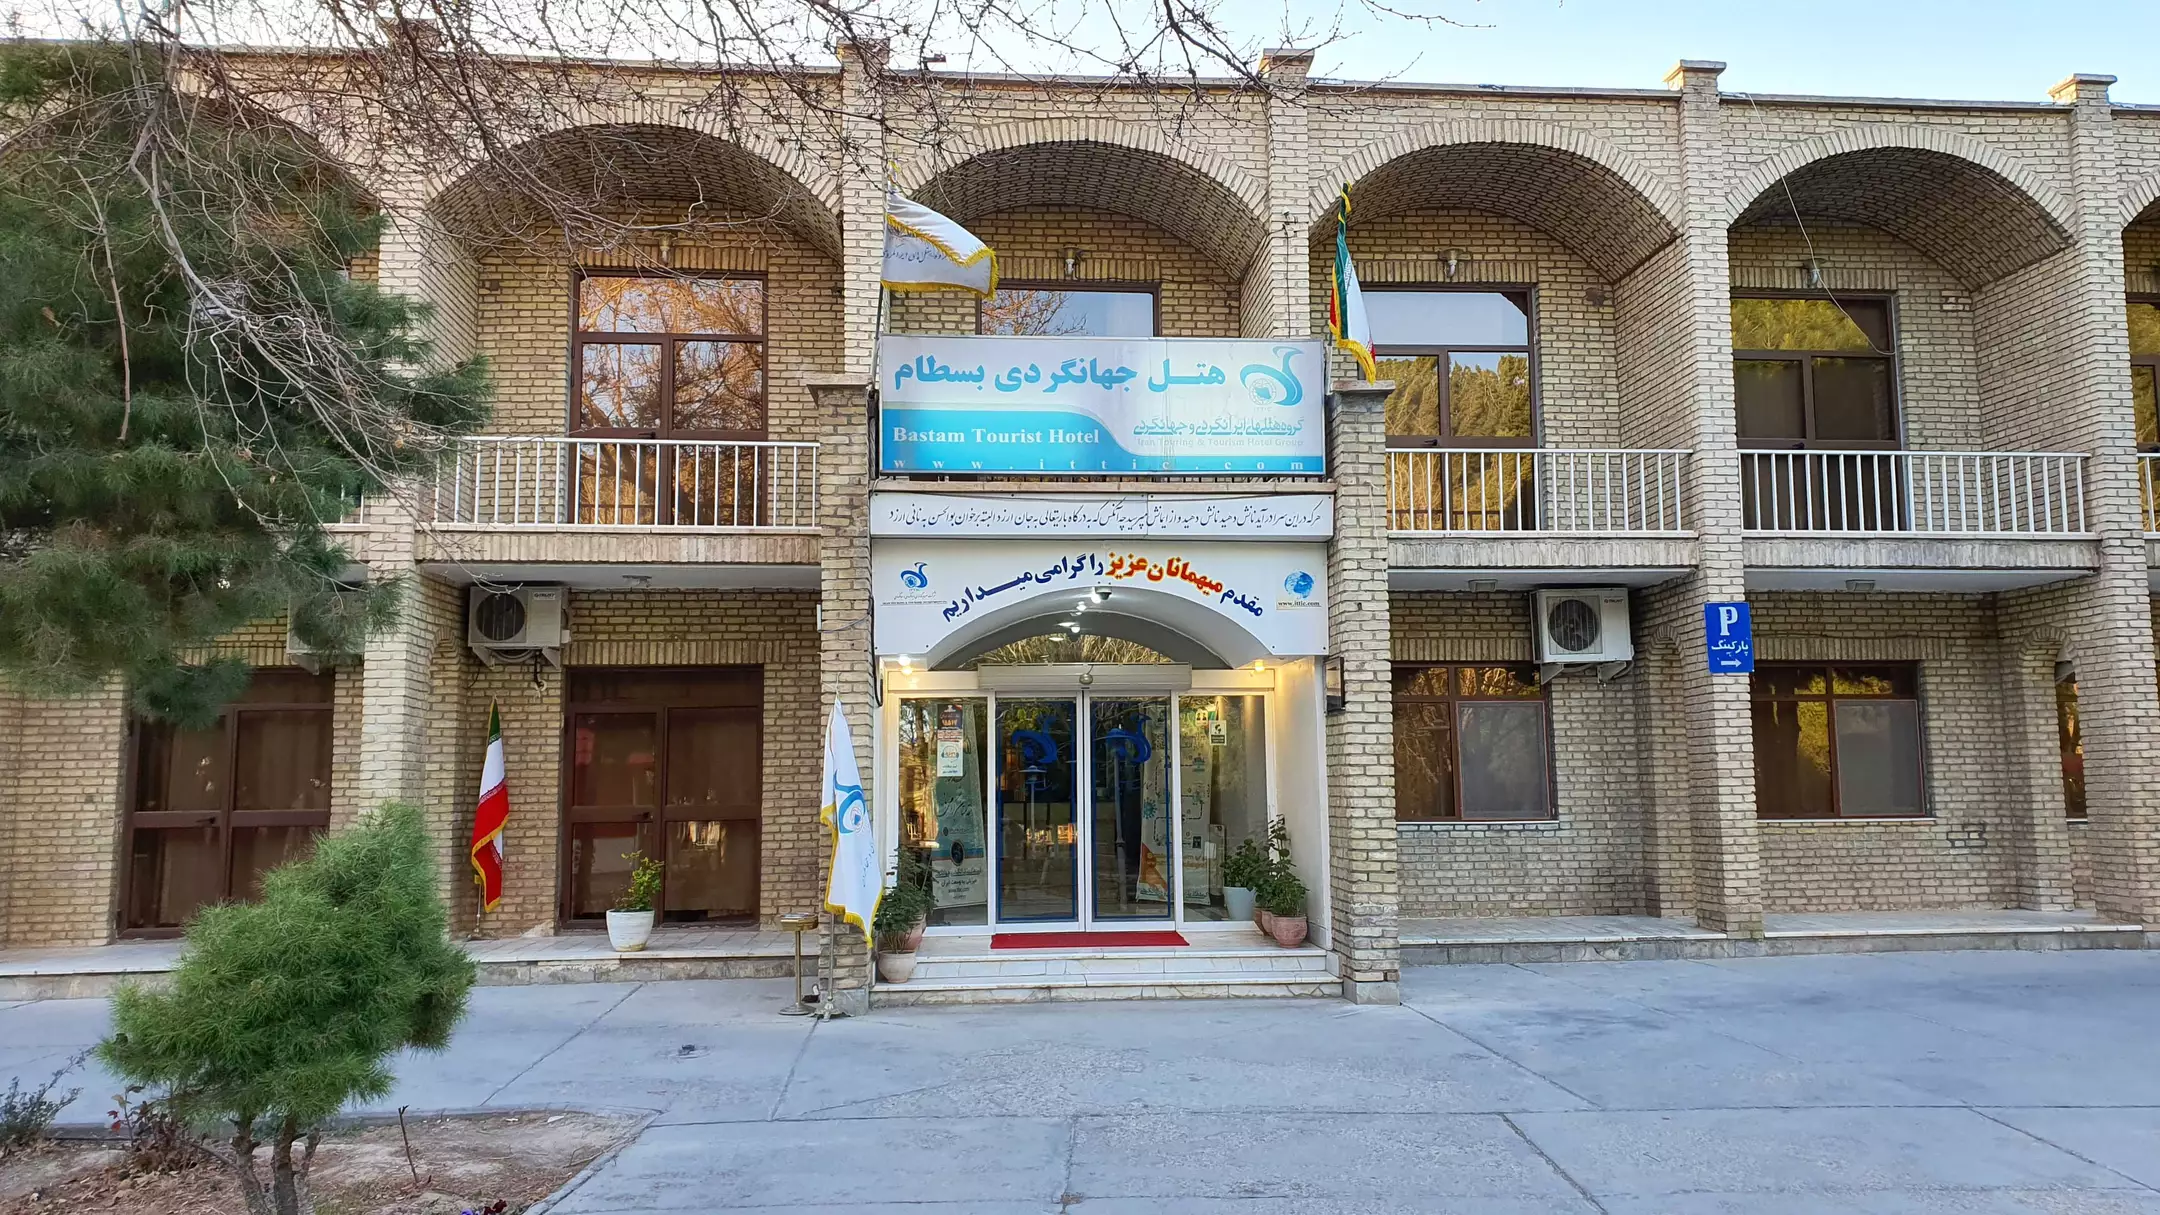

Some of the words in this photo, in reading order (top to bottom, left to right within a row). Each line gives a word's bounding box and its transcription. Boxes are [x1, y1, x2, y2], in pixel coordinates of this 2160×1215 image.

[894, 354, 985, 392] بسطام
[994, 356, 1138, 393] جهانگردی
[1148, 357, 1226, 393] هتل
[893, 427, 965, 443] Bastam
[971, 428, 1043, 444] Tourist
[1049, 429, 1100, 444] Hotel
[1137, 438, 1156, 447] Iran
[1159, 438, 1194, 449] Touring
[1197, 438, 1206, 447] &
[1208, 437, 1245, 447] Tourism
[1247, 437, 1272, 447] Hotel
[1274, 437, 1304, 448] Group
[1188, 424, 1195, 435] و
[1272, 513, 1287, 526] سرا
[1285, 513, 1299, 527] این
[1034, 553, 1087, 584] گرامی
[1089, 552, 1104, 576] را
[1105, 552, 1149, 580] عزیز
[1147, 556, 1223, 597] میهمانان
[1219, 588, 1264, 617] مقدم
[1719, 606, 1738, 636] P
[1711, 638, 1749, 657] پارکینگ
